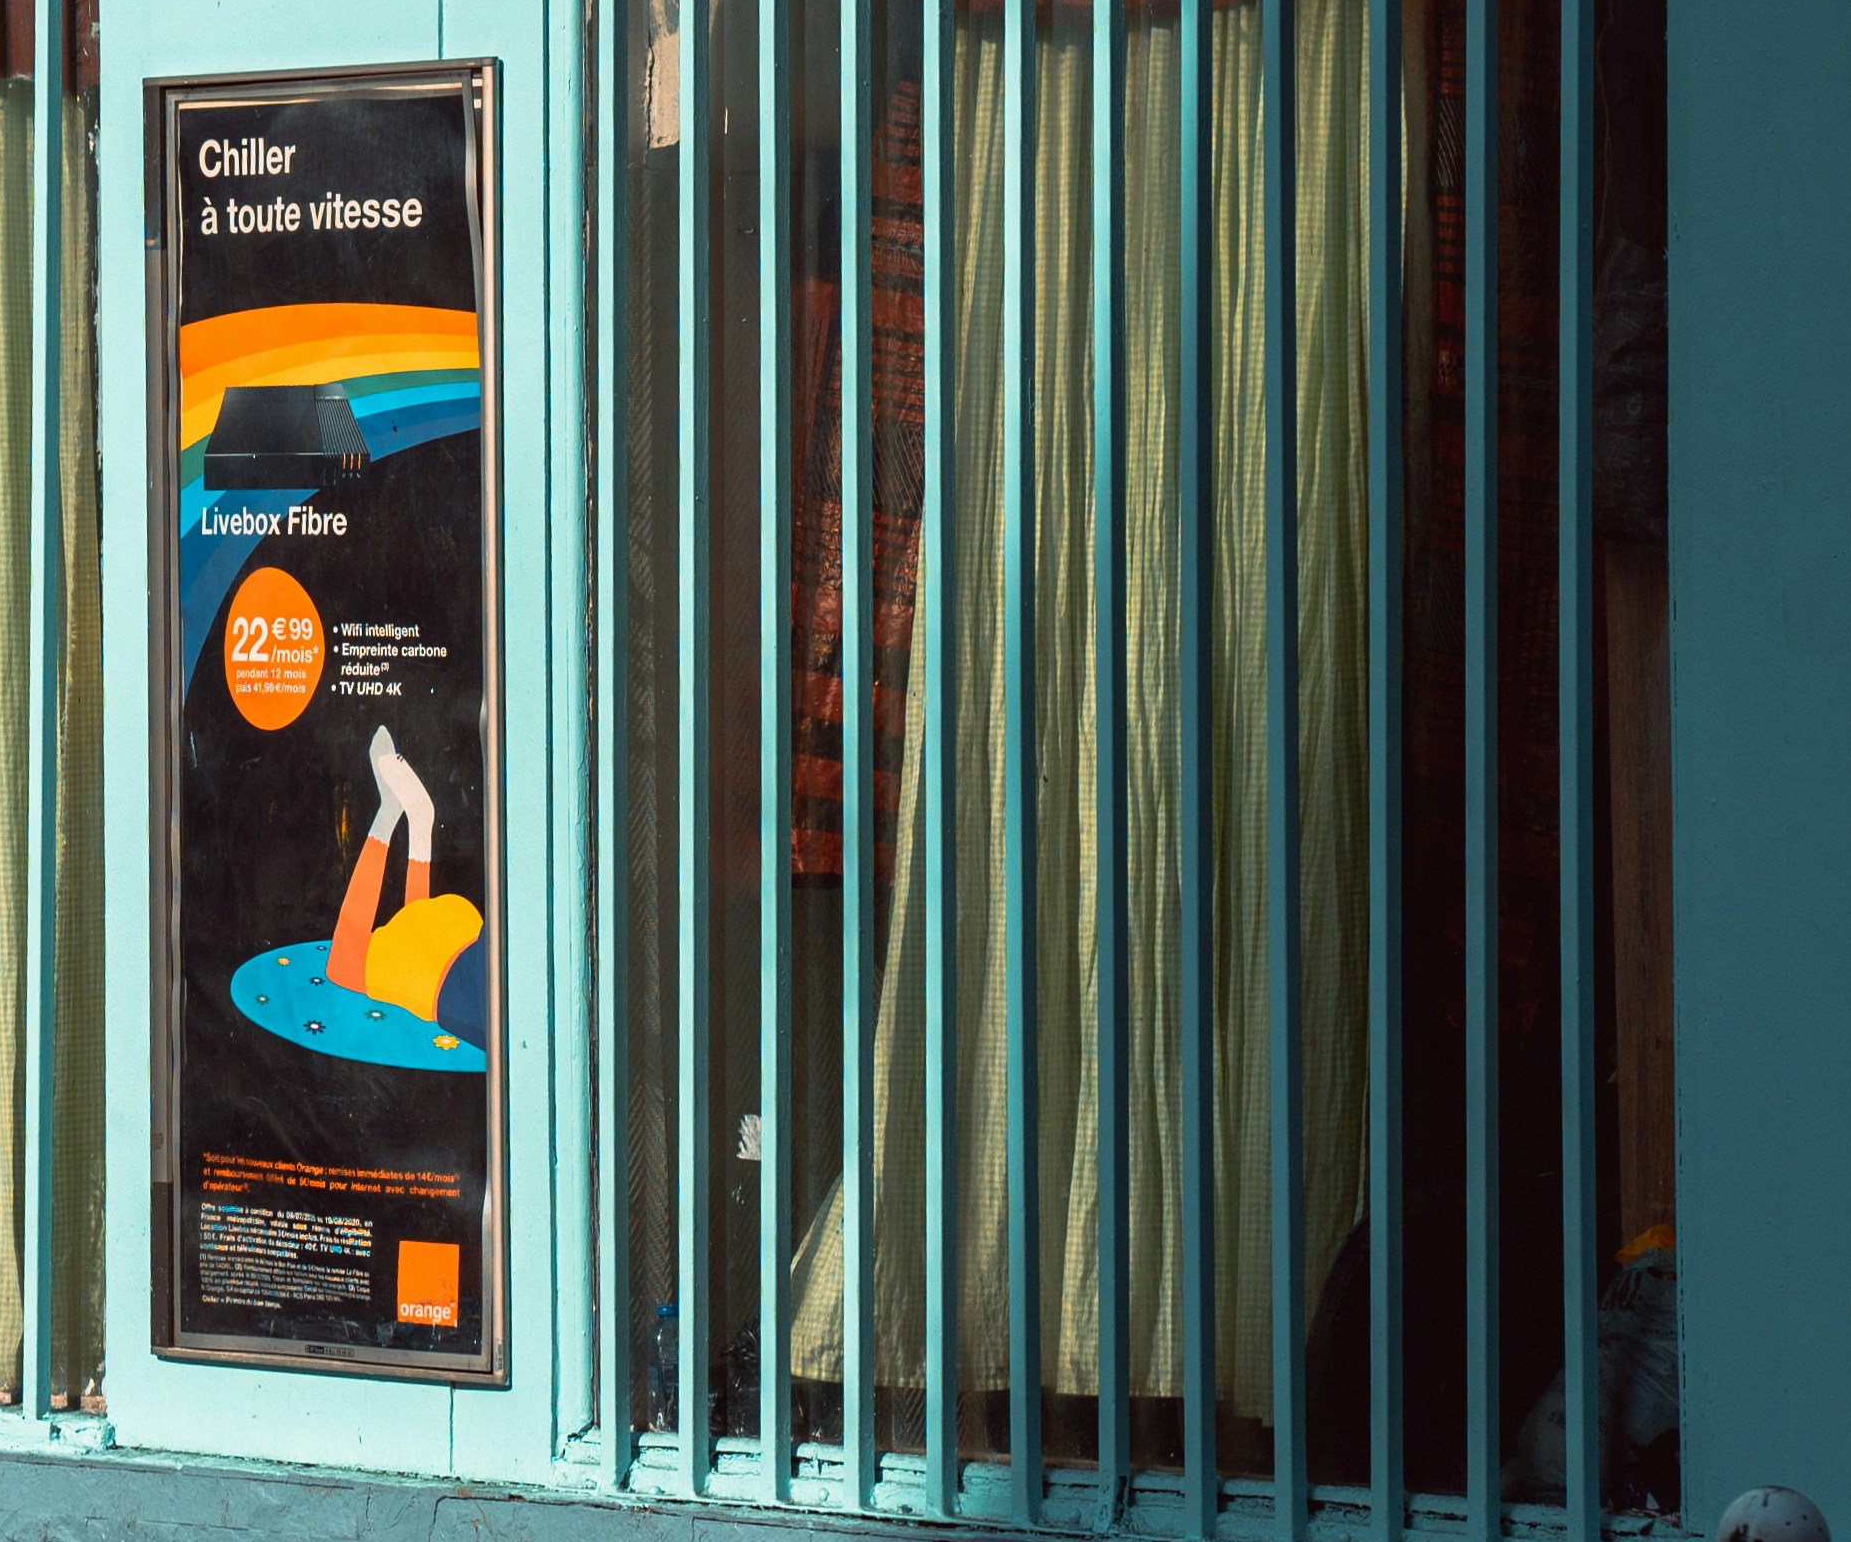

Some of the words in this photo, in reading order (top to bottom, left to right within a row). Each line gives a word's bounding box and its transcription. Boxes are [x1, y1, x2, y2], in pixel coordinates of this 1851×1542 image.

[198, 138, 297, 178] Chiller
[201, 197, 218, 235] à
[227, 196, 301, 234] toute
[309, 192, 423, 231] vitesse
[201, 507, 281, 537] Livebox
[287, 505, 348, 536] Fibre
[340, 623, 363, 637] Wifi
[365, 623, 420, 640] intelligent
[341, 643, 399, 659] Empreinte
[401, 643, 448, 657] carbone
[236, 668, 268, 680] pendant
[271, 668, 282, 679] 12
[284, 668, 307, 680] mois
[235, 683, 252, 695] puis
[339, 681, 354, 695] TV
[357, 681, 384, 696] UHD
[385, 682, 402, 696] 4K
[400, 1303, 451, 1323] orange
